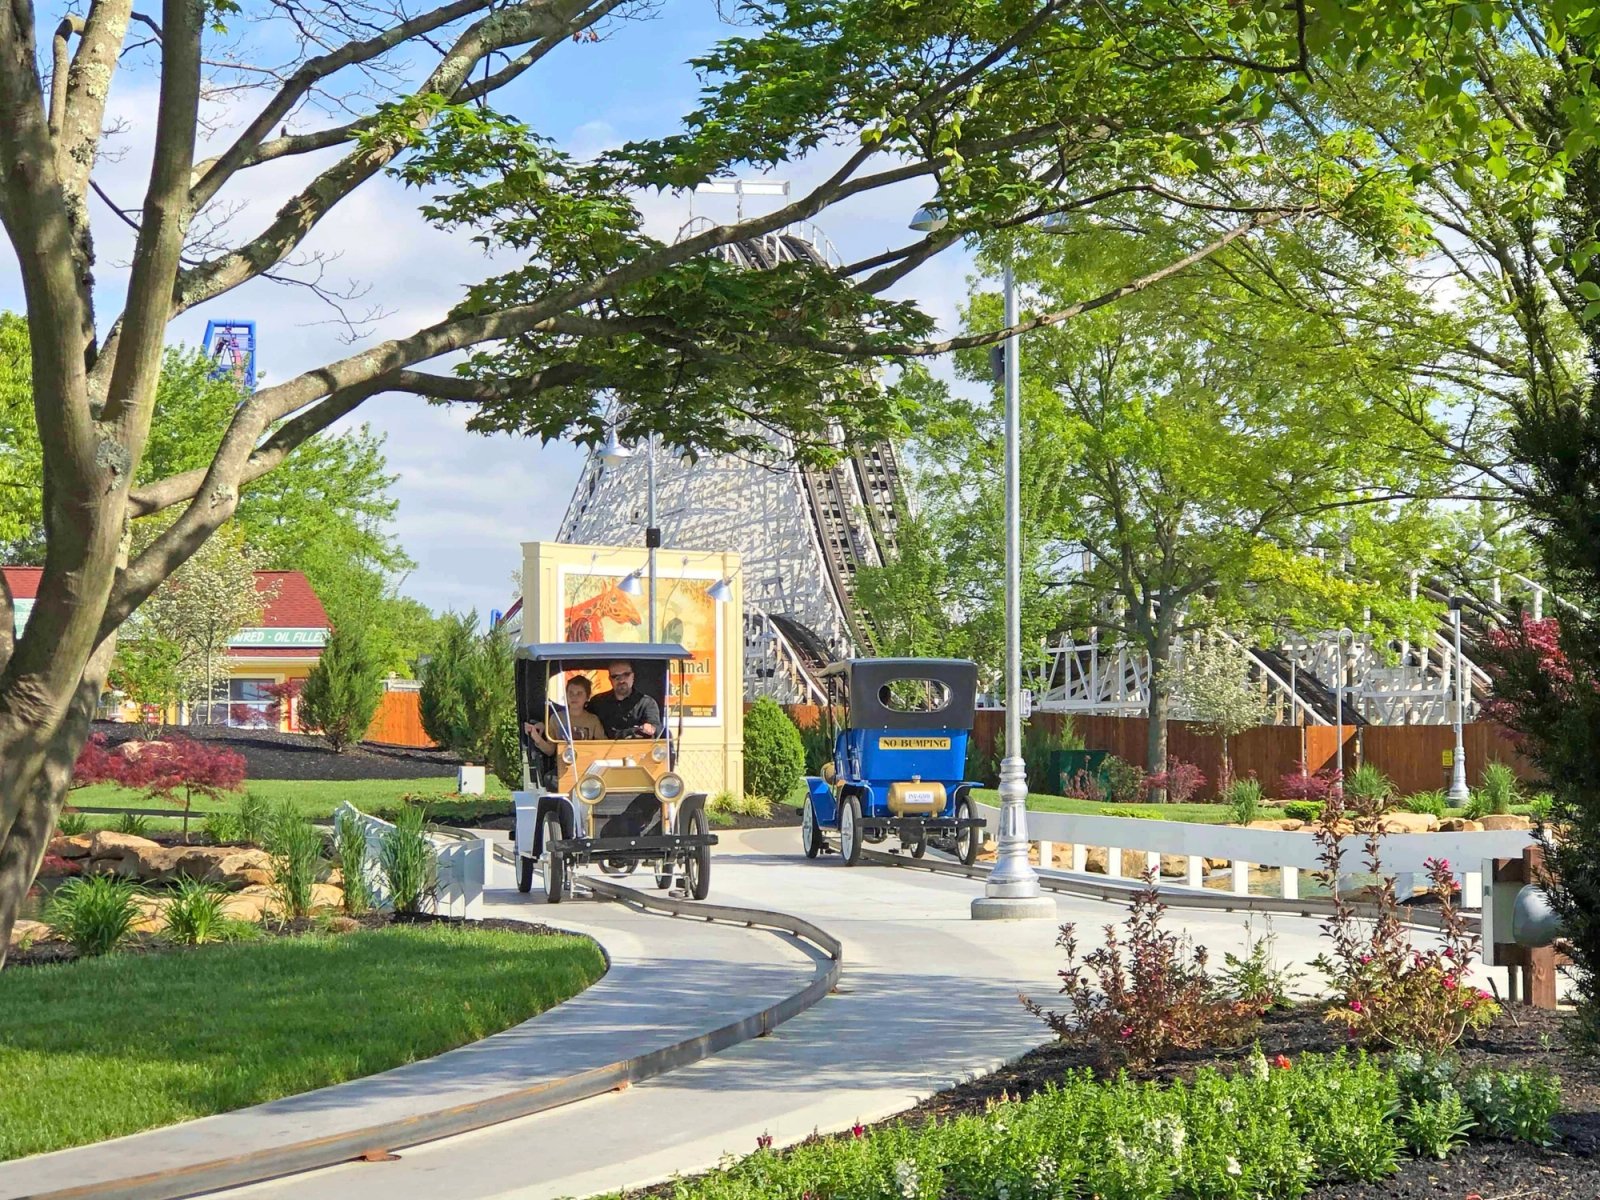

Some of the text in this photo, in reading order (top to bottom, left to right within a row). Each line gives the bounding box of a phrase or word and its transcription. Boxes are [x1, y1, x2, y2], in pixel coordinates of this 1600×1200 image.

[274, 631, 290, 642] OIL
[884, 739, 947, 748] NO BUMPING
